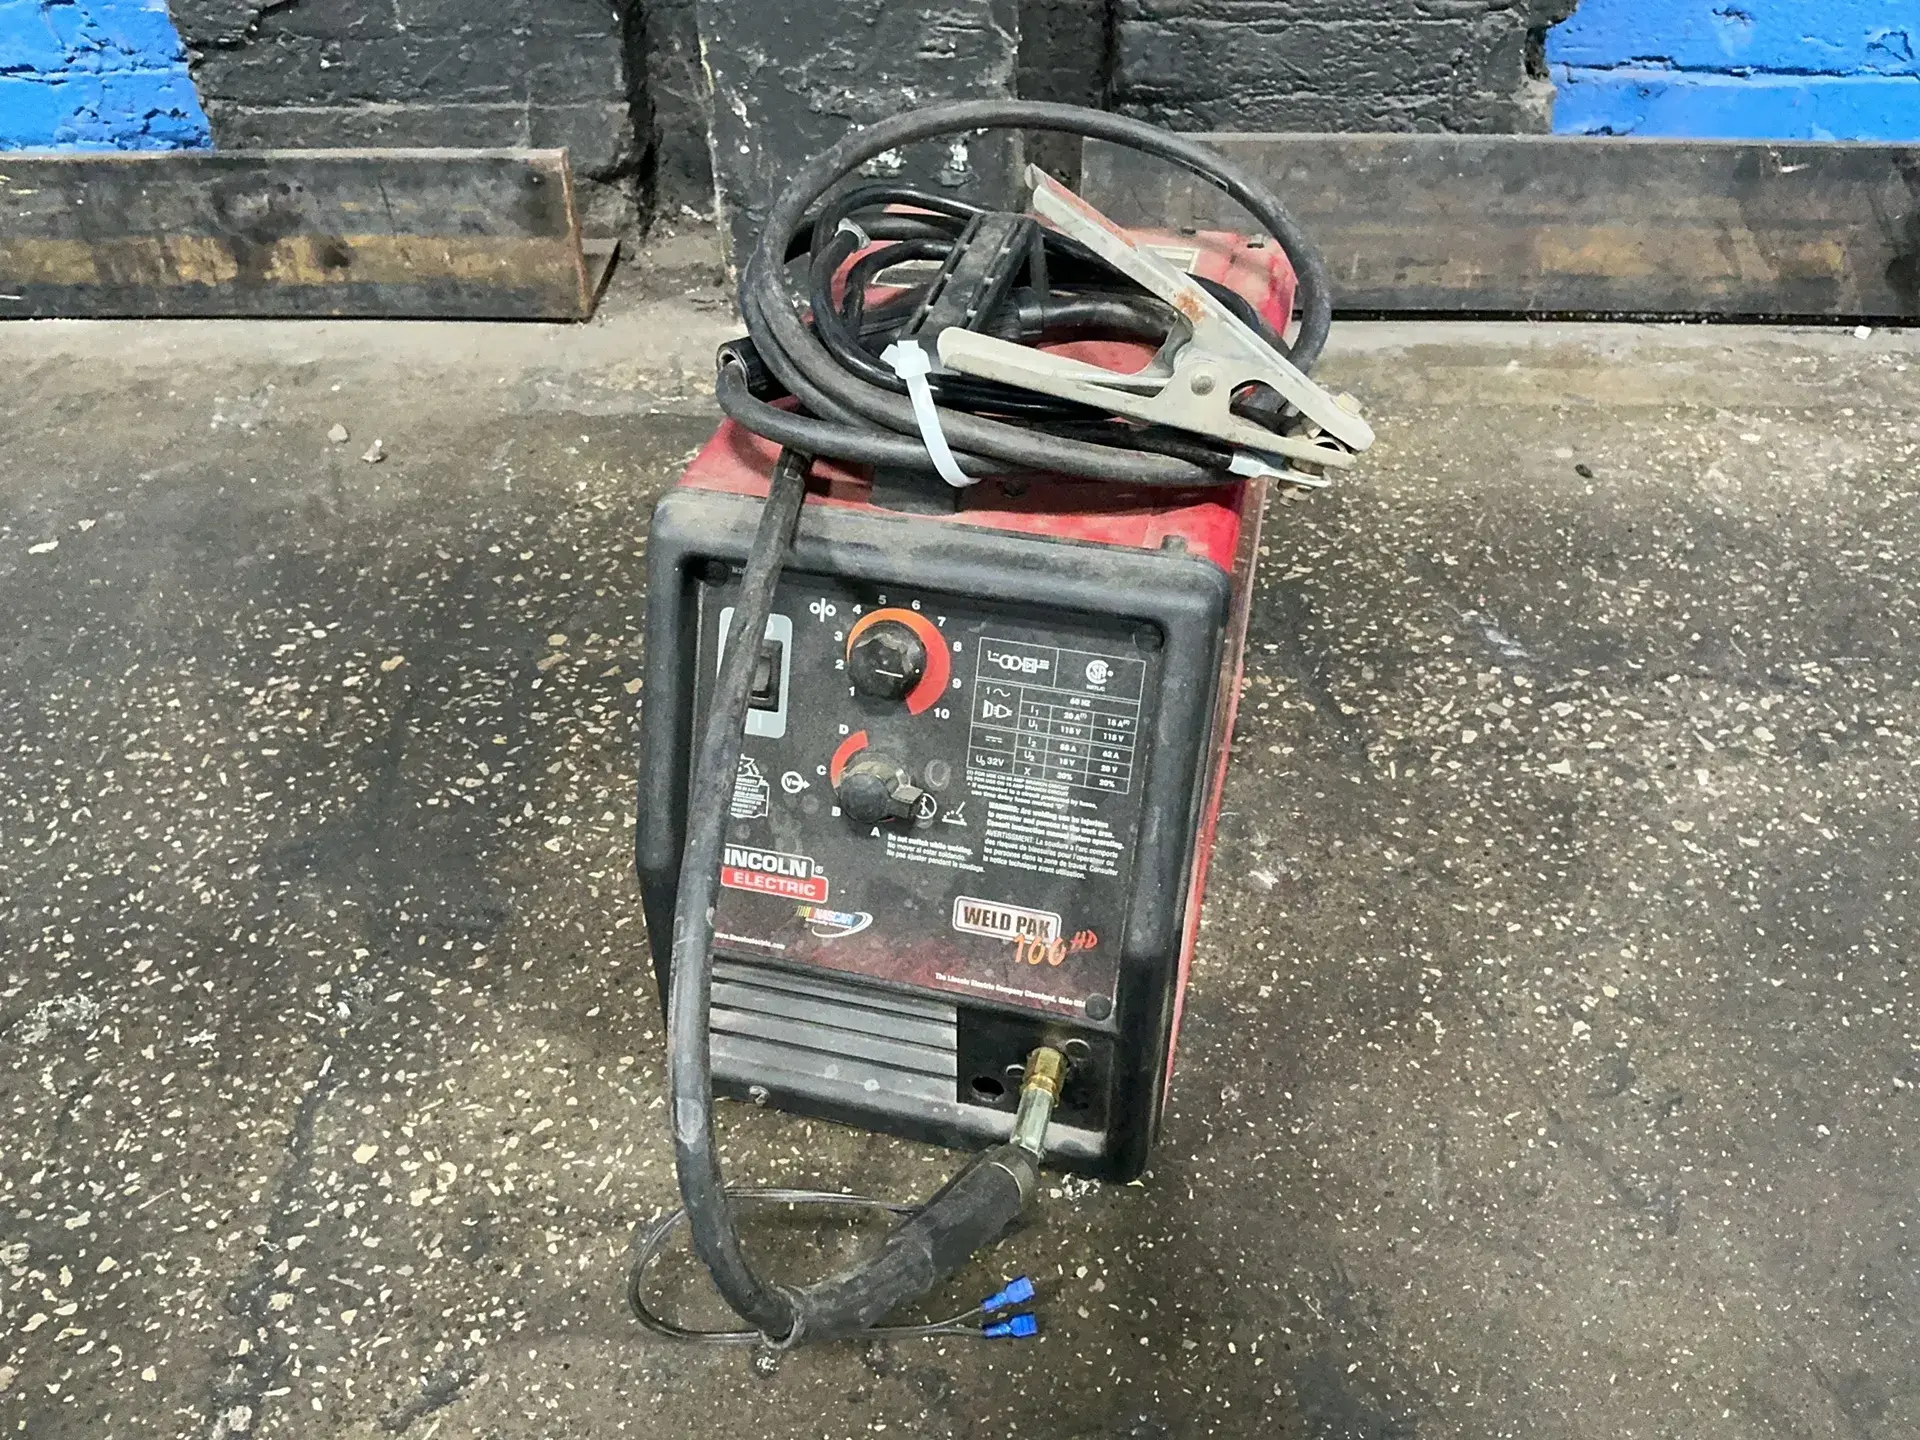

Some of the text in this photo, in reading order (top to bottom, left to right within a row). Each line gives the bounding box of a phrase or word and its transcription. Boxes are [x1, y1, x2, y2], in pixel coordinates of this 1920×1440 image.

[879, 594, 887, 605] 5
[852, 604, 862, 615] 4
[911, 600, 921, 611] 6
[937, 616, 947, 628] 7
[834, 631, 843, 642] 3
[952, 641, 962, 653] 8
[834, 659, 844, 670] 2
[952, 678, 962, 689] 9
[848, 686, 856, 697] 1
[1069, 697, 1081, 706] 60
[933, 708, 950, 719] 10
[1063, 712, 1075, 720] 20
[838, 723, 849, 735] D
[1075, 728, 1082, 736] V
[1118, 735, 1125, 743] V
[1070, 745, 1078, 754] A
[1112, 752, 1120, 760] A
[986, 757, 1005, 768] 32V
[1069, 759, 1076, 768] V
[816, 765, 827, 776] C
[1024, 767, 1031, 776] X
[1112, 767, 1119, 775] V
[831, 806, 842, 818] B
[870, 826, 881, 838] A
[724, 848, 807, 877] INCOLN
[733, 872, 816, 897] ELECTRIC
[964, 906, 1051, 939] WELD PAK
[935, 972, 947, 982] The
